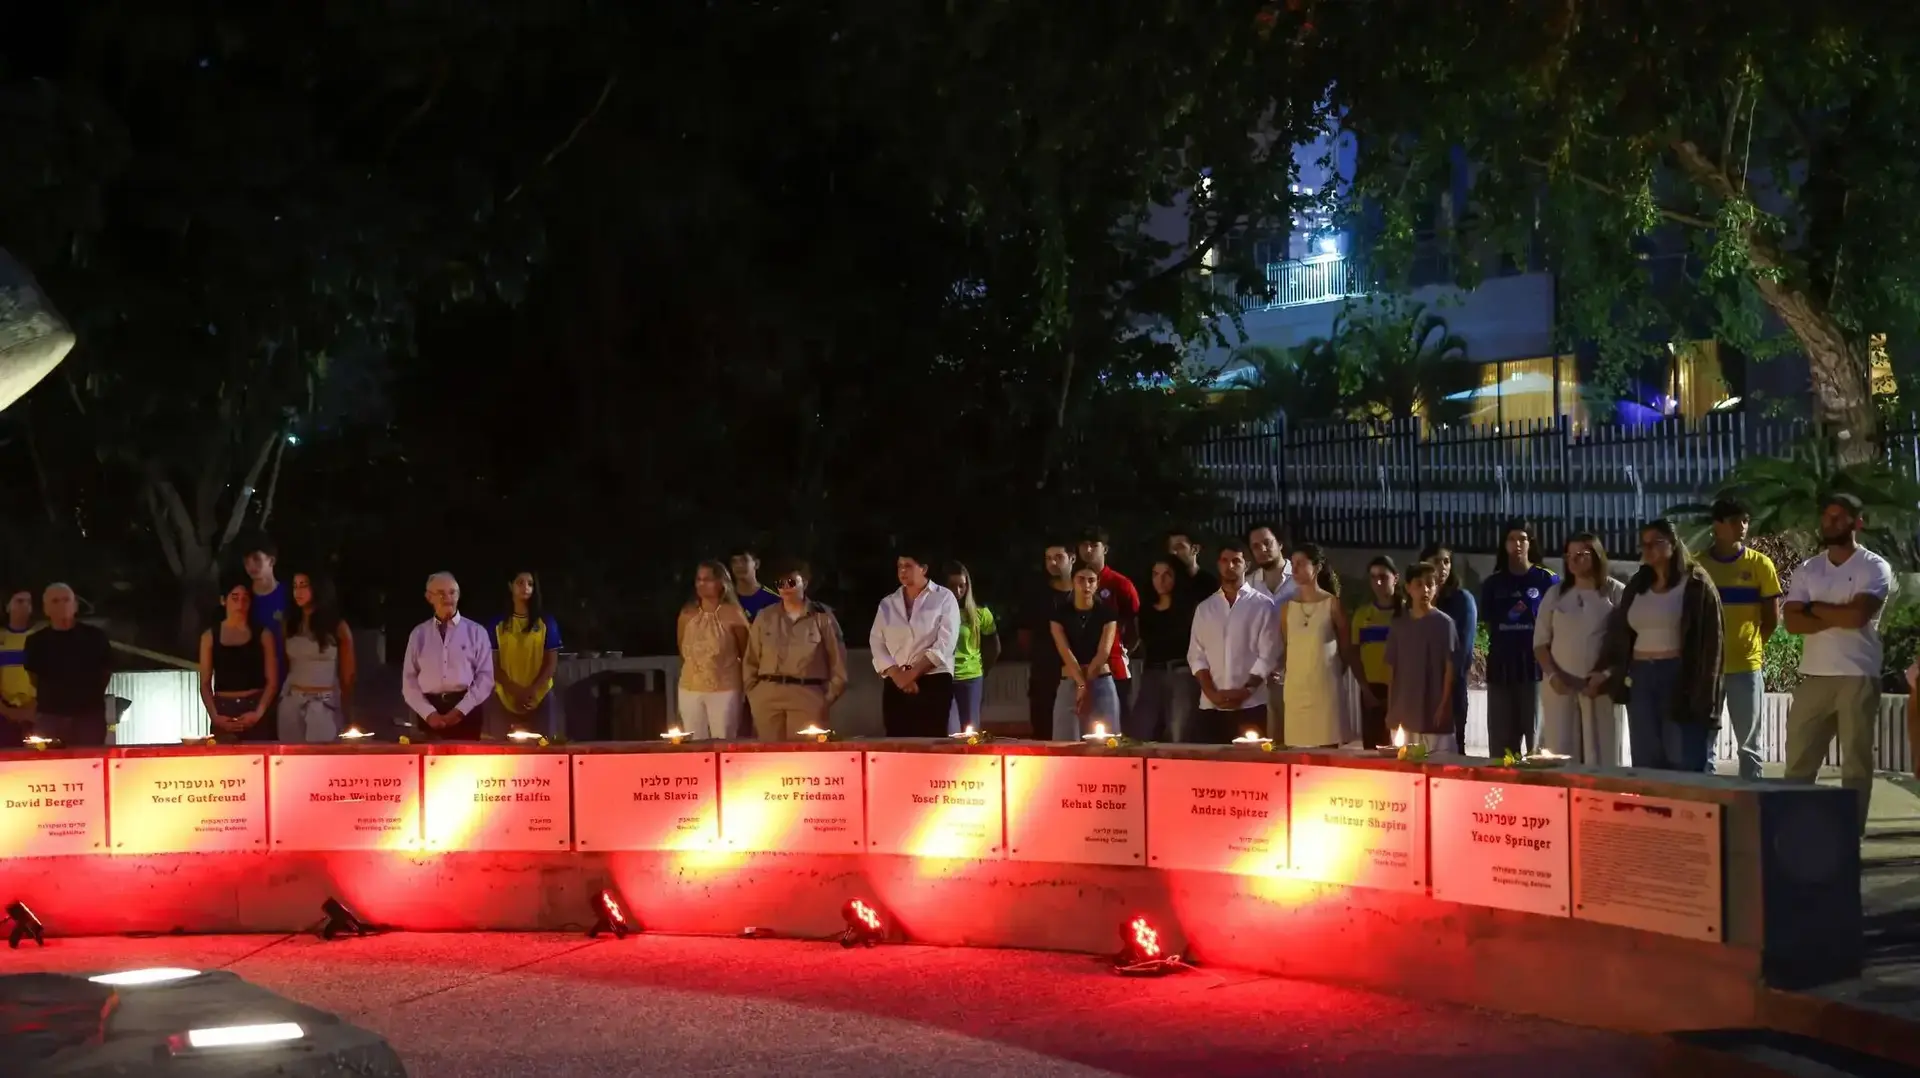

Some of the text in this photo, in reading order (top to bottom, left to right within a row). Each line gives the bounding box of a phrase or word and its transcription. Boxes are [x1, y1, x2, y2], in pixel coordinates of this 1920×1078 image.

[154, 778, 246, 790] יוסף גוטפרוינד
[328, 777, 402, 788] משה ויינברג
[476, 776, 551, 789] אליעזר חלפין
[640, 774, 699, 788] מרק סלבין
[781, 776, 845, 787] זאב פרידמן
[929, 779, 985, 792] יוסף רומנו
[28, 782, 84, 793] דוד ברגר
[1077, 783, 1127, 796] קהת שור
[152, 792, 246, 803] Yosef Gutfreund
[309, 792, 402, 803] Moshe Weinberg
[473, 791, 551, 802] Eliezer Halfin
[633, 791, 699, 802] Mark Slavin
[764, 791, 845, 801] Zeev Friedman
[911, 793, 939, 804] Yosef
[1191, 787, 1269, 801] אנדריי שפיצר
[6, 798, 85, 809] David Berger
[1061, 798, 1127, 810] Kehat Schor
[1329, 796, 1407, 812] עמיצור שפירא
[1190, 804, 1269, 819] Andrei Spitzer
[1367, 817, 1407, 832] Shapira
[1472, 811, 1551, 830] יעקב שפרינגר
[1471, 830, 1552, 851] Yacov Springer
